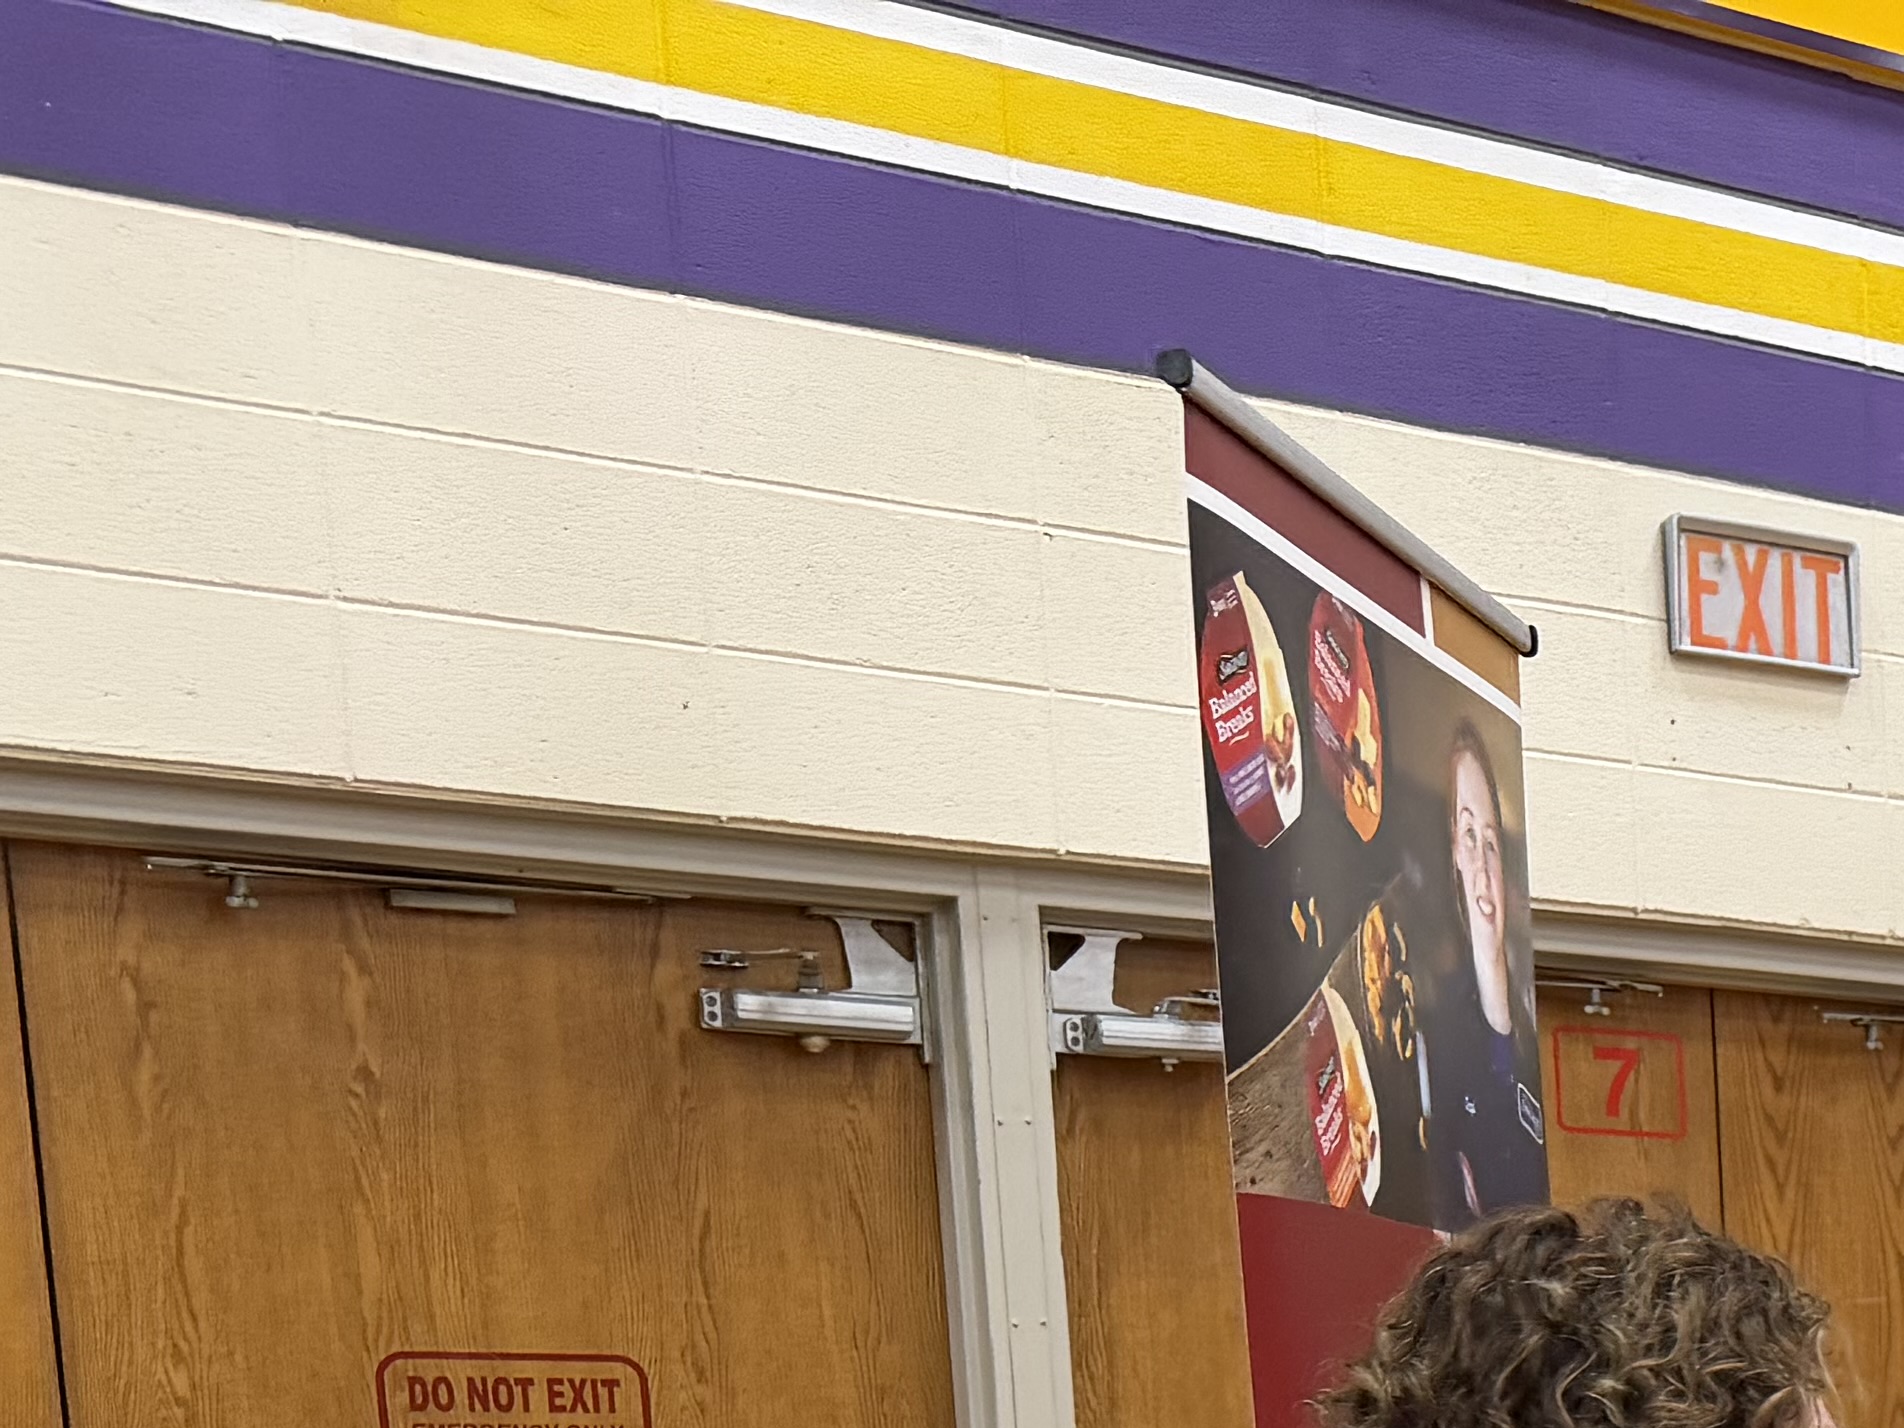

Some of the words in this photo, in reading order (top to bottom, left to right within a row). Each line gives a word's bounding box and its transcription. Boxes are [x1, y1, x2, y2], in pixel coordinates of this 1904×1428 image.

[1686, 535, 1842, 666] EXIT
[1592, 1045, 1641, 1119] 7
[406, 1375, 456, 1412] DO
[466, 1376, 535, 1413] NOT
[546, 1377, 622, 1415] EXIT
